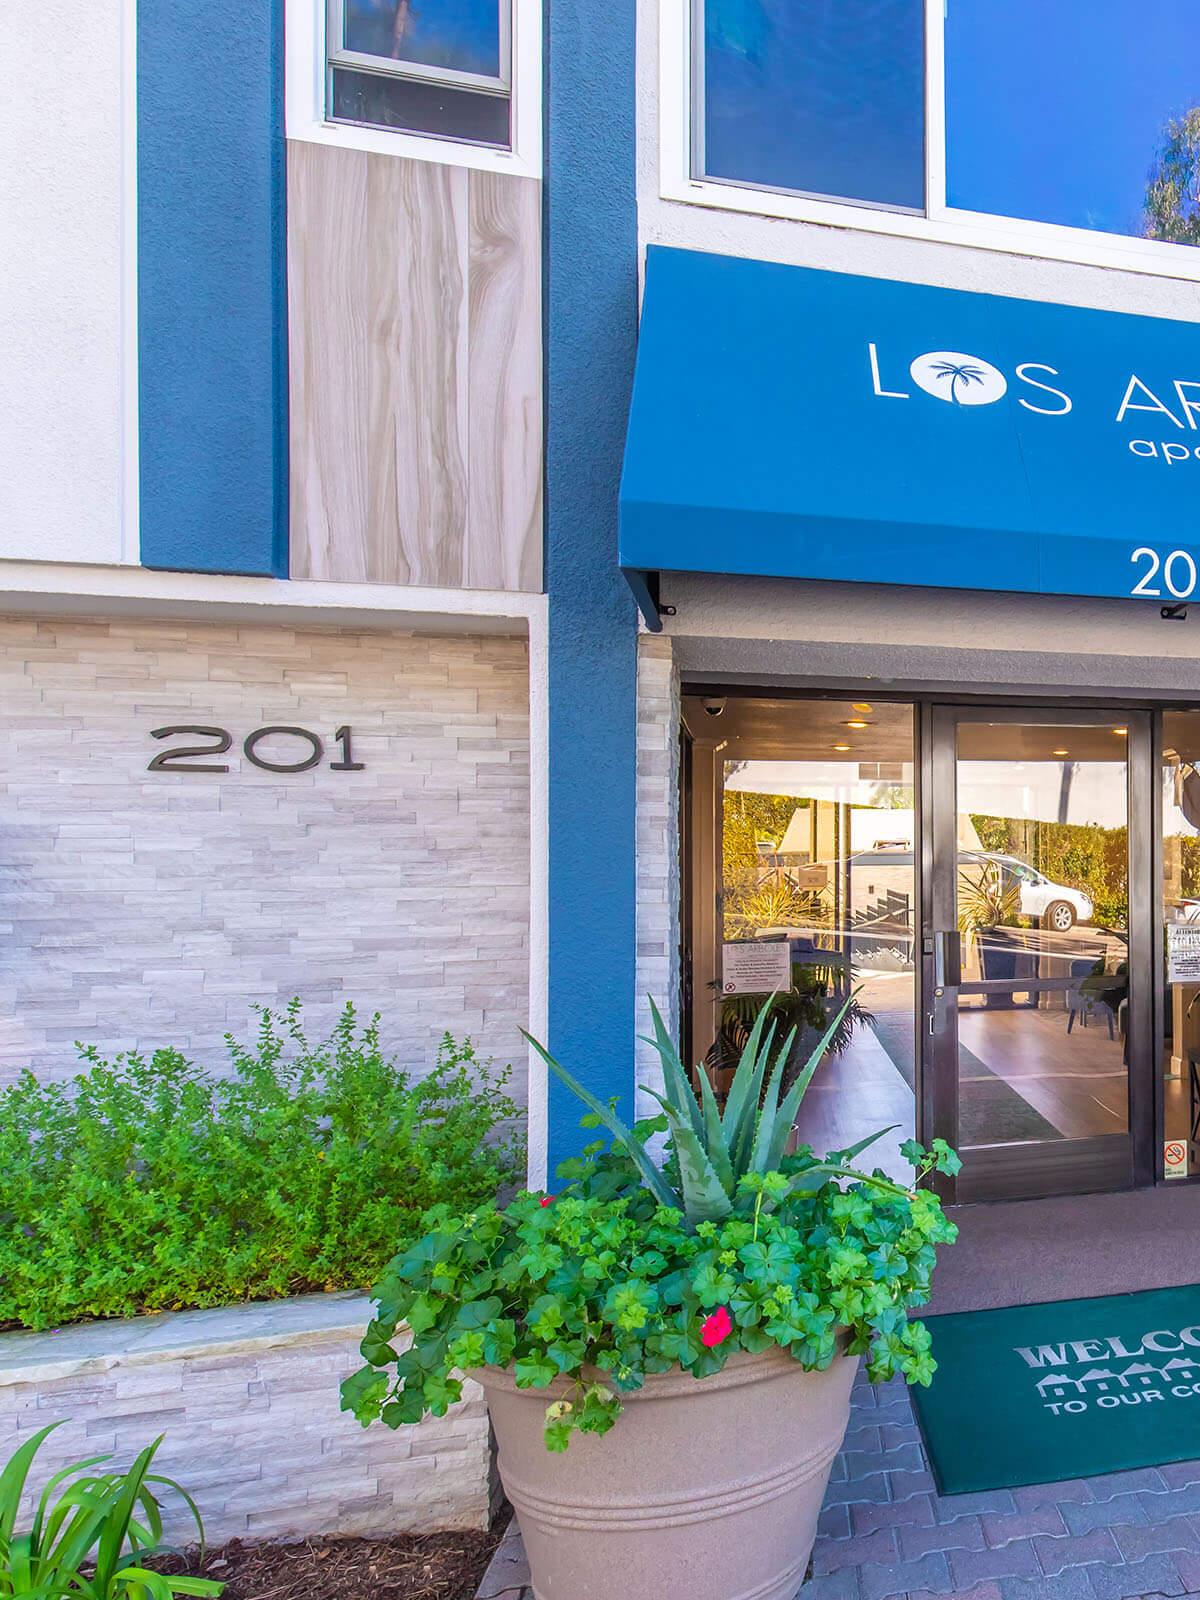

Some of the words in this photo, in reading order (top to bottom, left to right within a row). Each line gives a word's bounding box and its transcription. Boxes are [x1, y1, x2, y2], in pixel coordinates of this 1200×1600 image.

[146, 725, 365, 773] 201
[1043, 1400, 1088, 1415] TO
[1096, 1388, 1166, 1408] OUR
